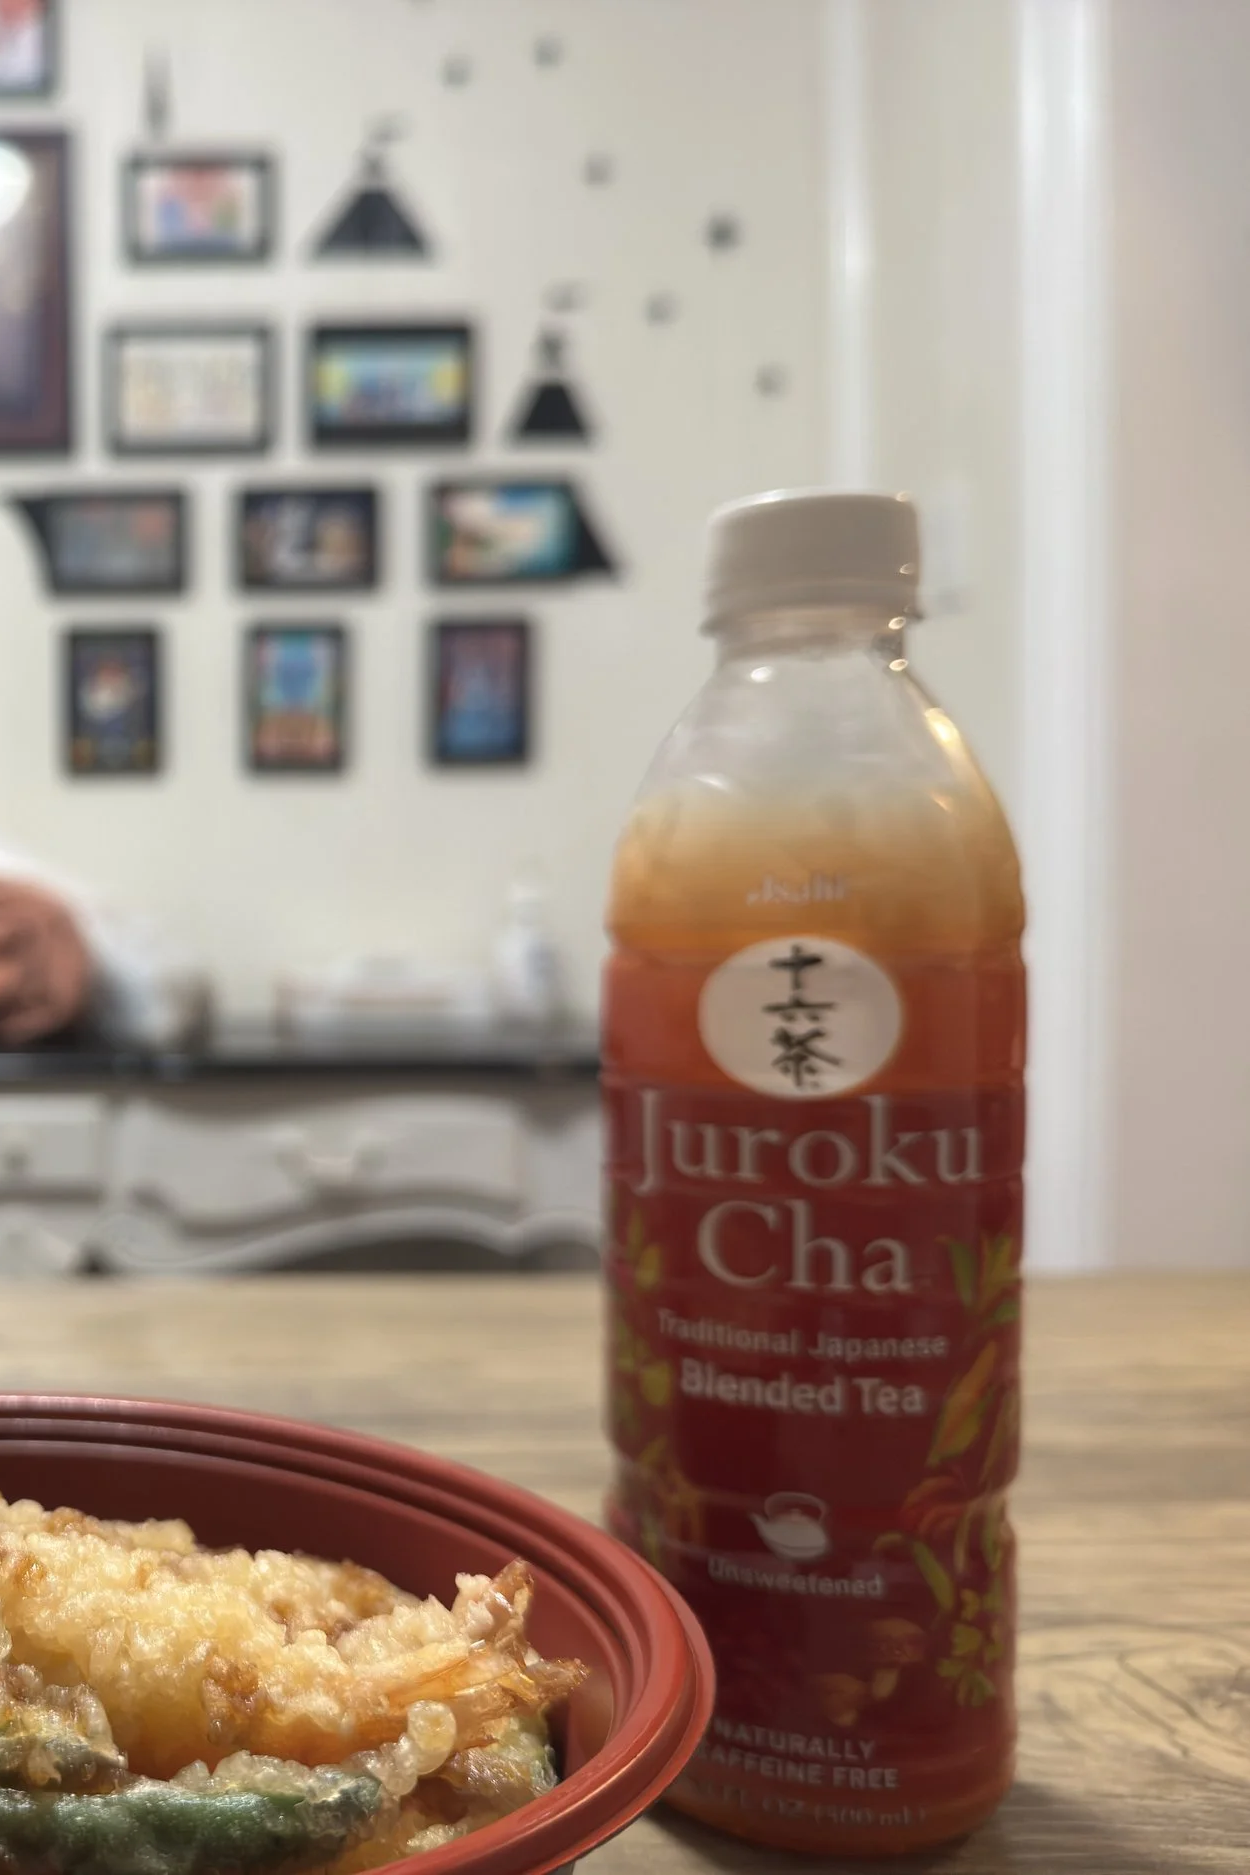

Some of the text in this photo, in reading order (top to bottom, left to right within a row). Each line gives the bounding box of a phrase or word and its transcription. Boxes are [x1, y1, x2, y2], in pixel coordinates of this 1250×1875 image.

[762, 944, 843, 1088] 十六茶
[636, 1089, 985, 1195] Juroku
[697, 1199, 913, 1292] Cha
[657, 1307, 947, 1363] Traditional Japanese
[681, 1357, 925, 1416] Blended Tea
[707, 1555, 885, 1598] Unsweetened
[713, 1716, 875, 1760] NATURALLY
[832, 1765, 899, 1789] FREE
